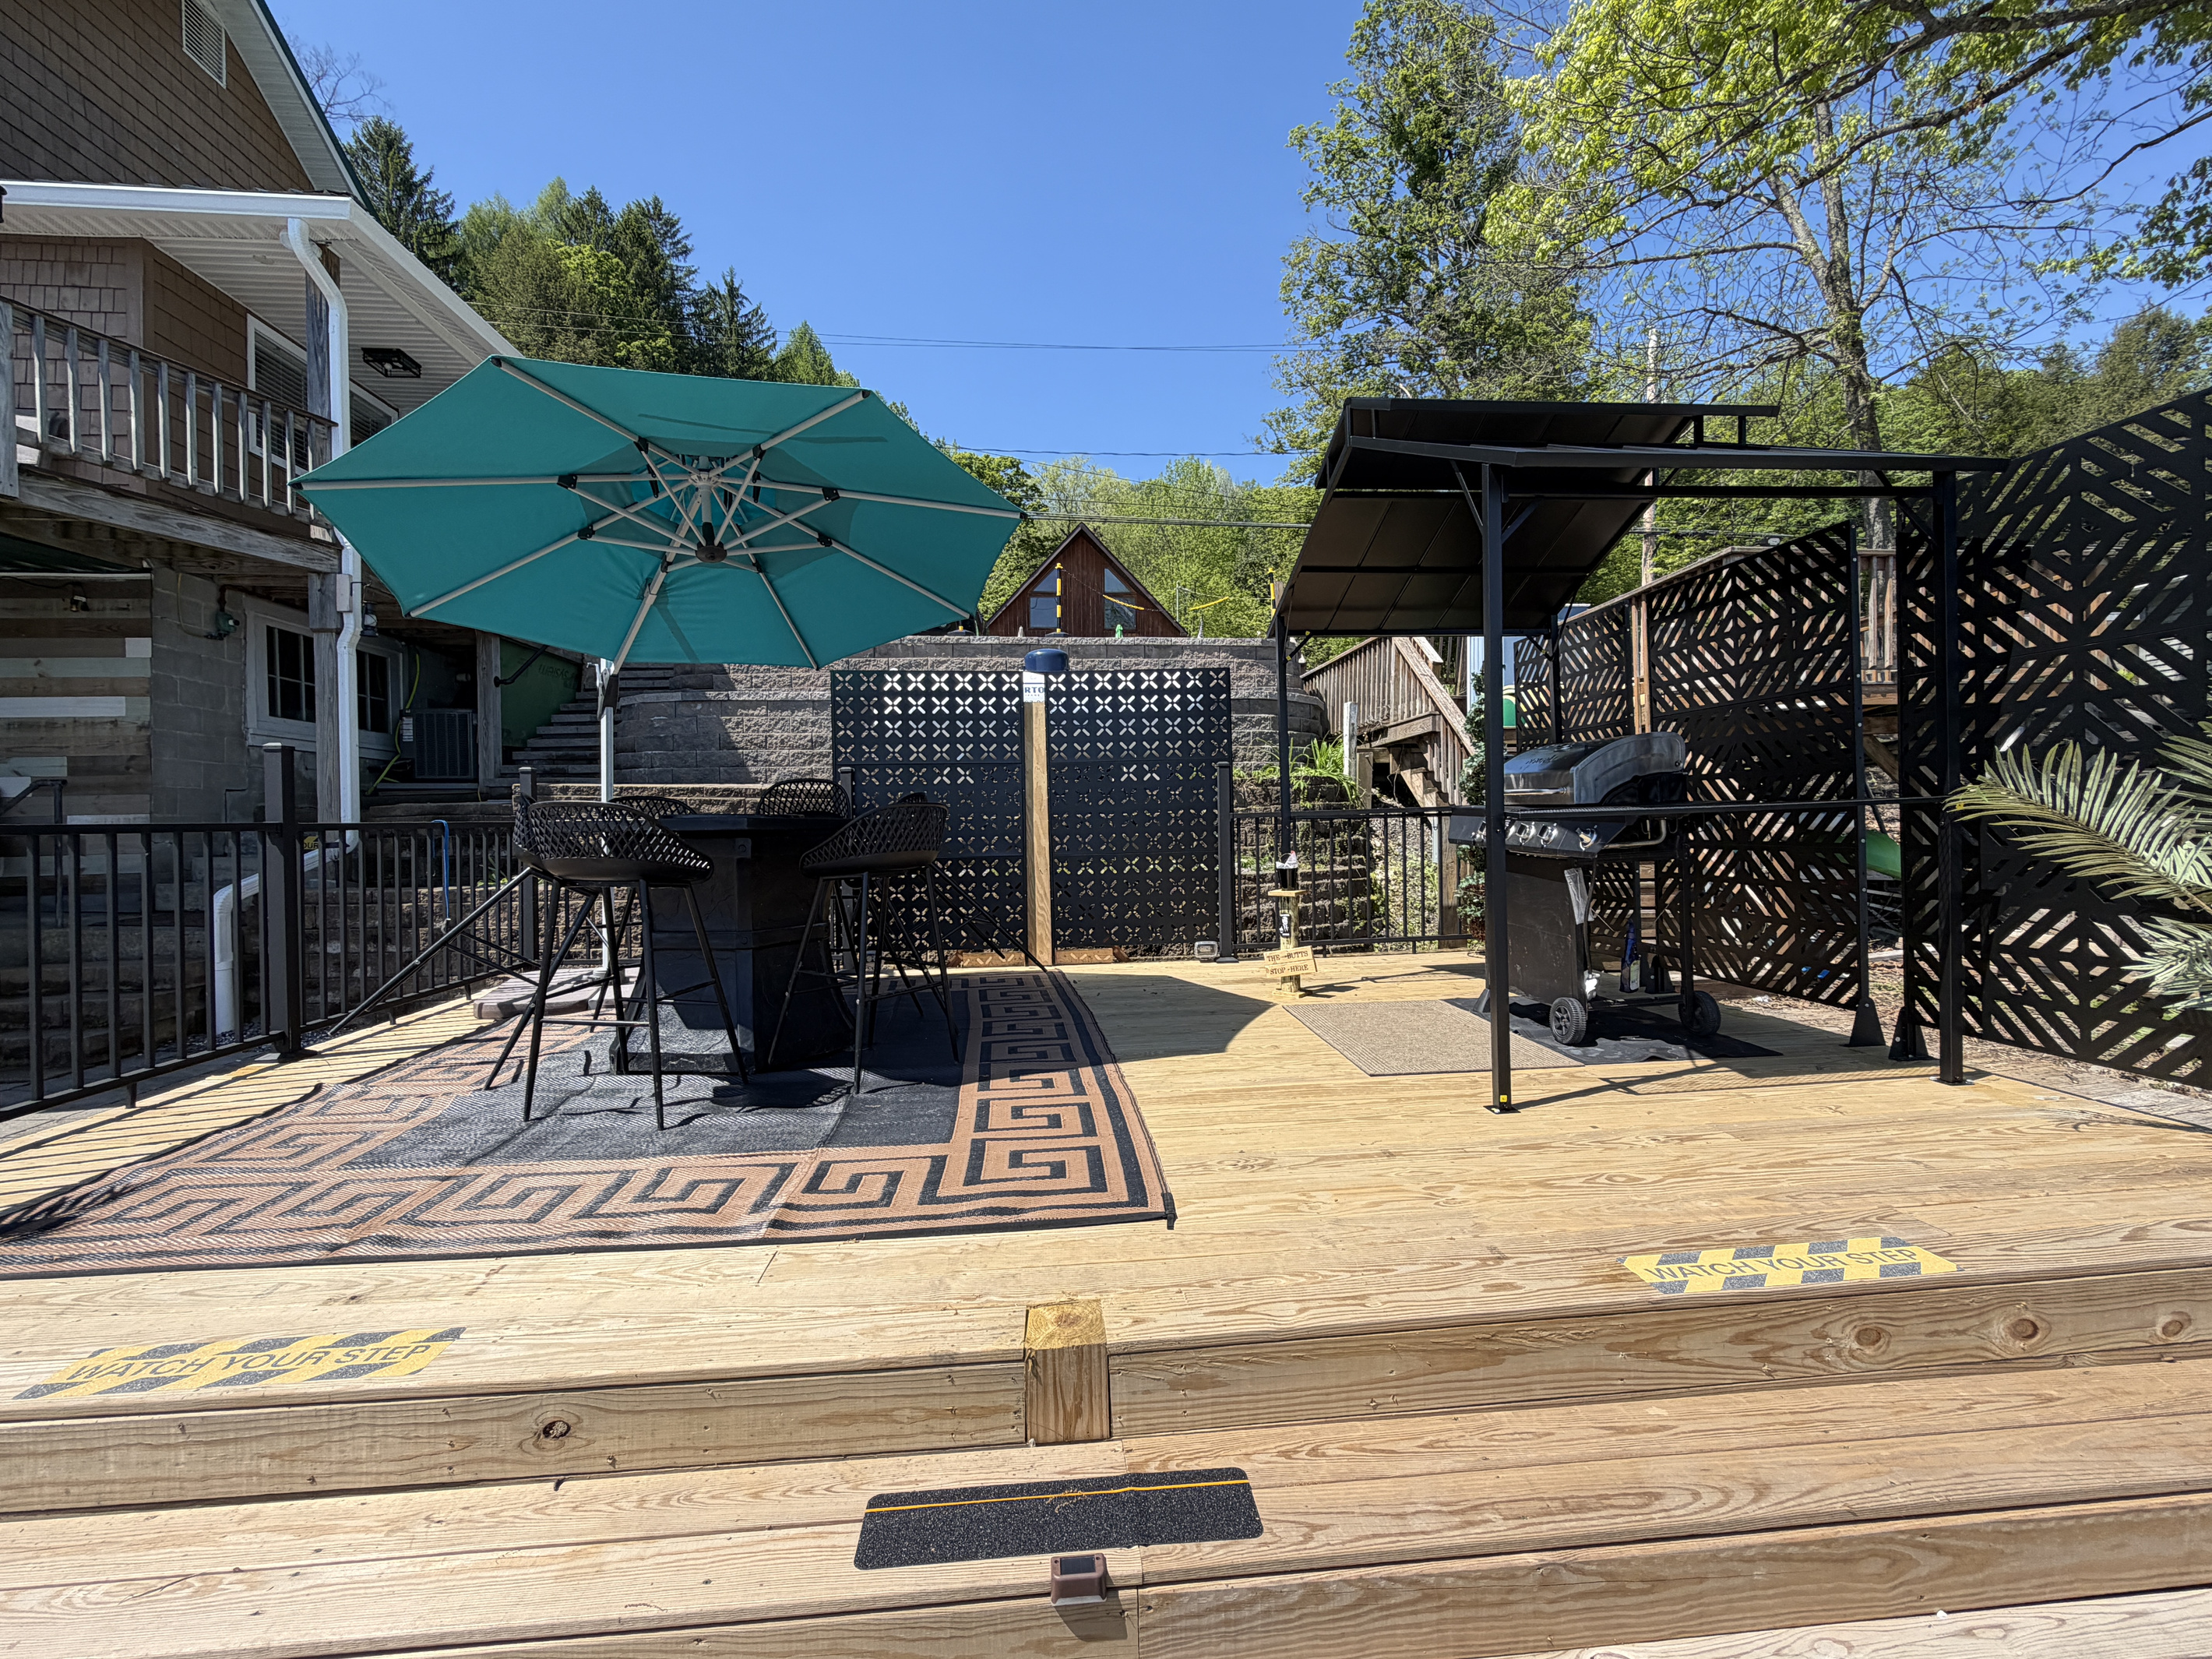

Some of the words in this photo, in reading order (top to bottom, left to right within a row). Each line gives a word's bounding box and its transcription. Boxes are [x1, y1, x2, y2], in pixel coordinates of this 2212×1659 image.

[1287, 950, 1309, 959] BUTTS
[1643, 1261, 1759, 1280] WATCH
[1754, 1256, 1850, 1270] YOUR
[1845, 1249, 1917, 1264] STEP
[66, 1358, 217, 1380] WATCH
[221, 1351, 331, 1370] YOUR
[334, 1345, 431, 1363] STEP
